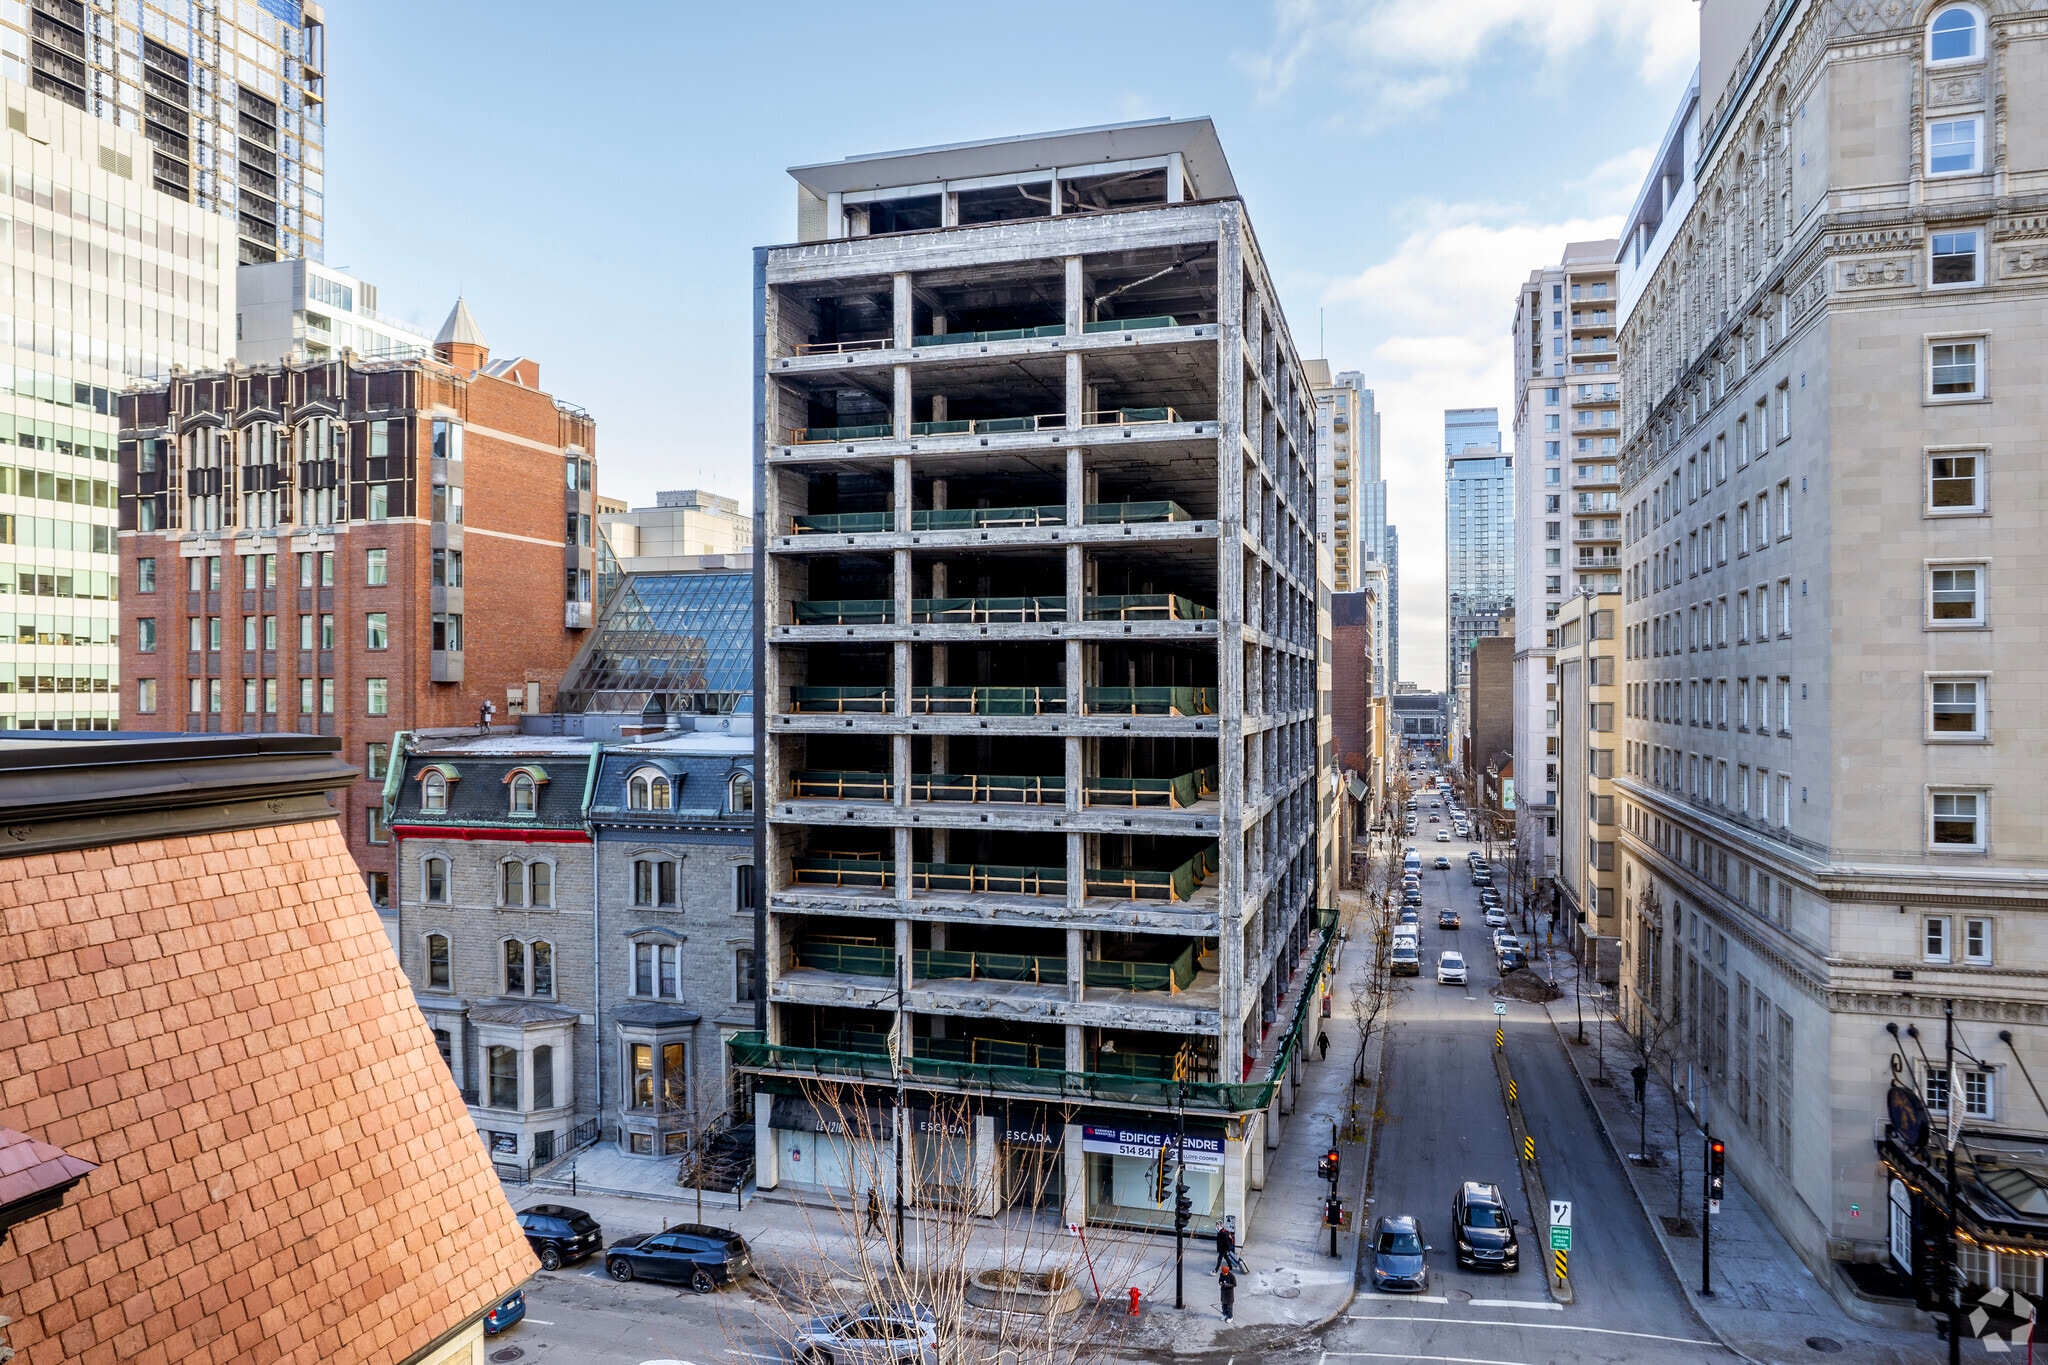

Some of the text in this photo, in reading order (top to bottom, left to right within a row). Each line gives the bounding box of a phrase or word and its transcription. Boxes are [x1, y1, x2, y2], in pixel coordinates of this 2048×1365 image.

[920, 1121, 965, 1135] ESCADA
[1006, 1130, 1052, 1144] ESCADA
[1119, 1130, 1161, 1145] ÉDIFICE
[1163, 1134, 1172, 1146] À
[1119, 1145, 1136, 1155] 514
